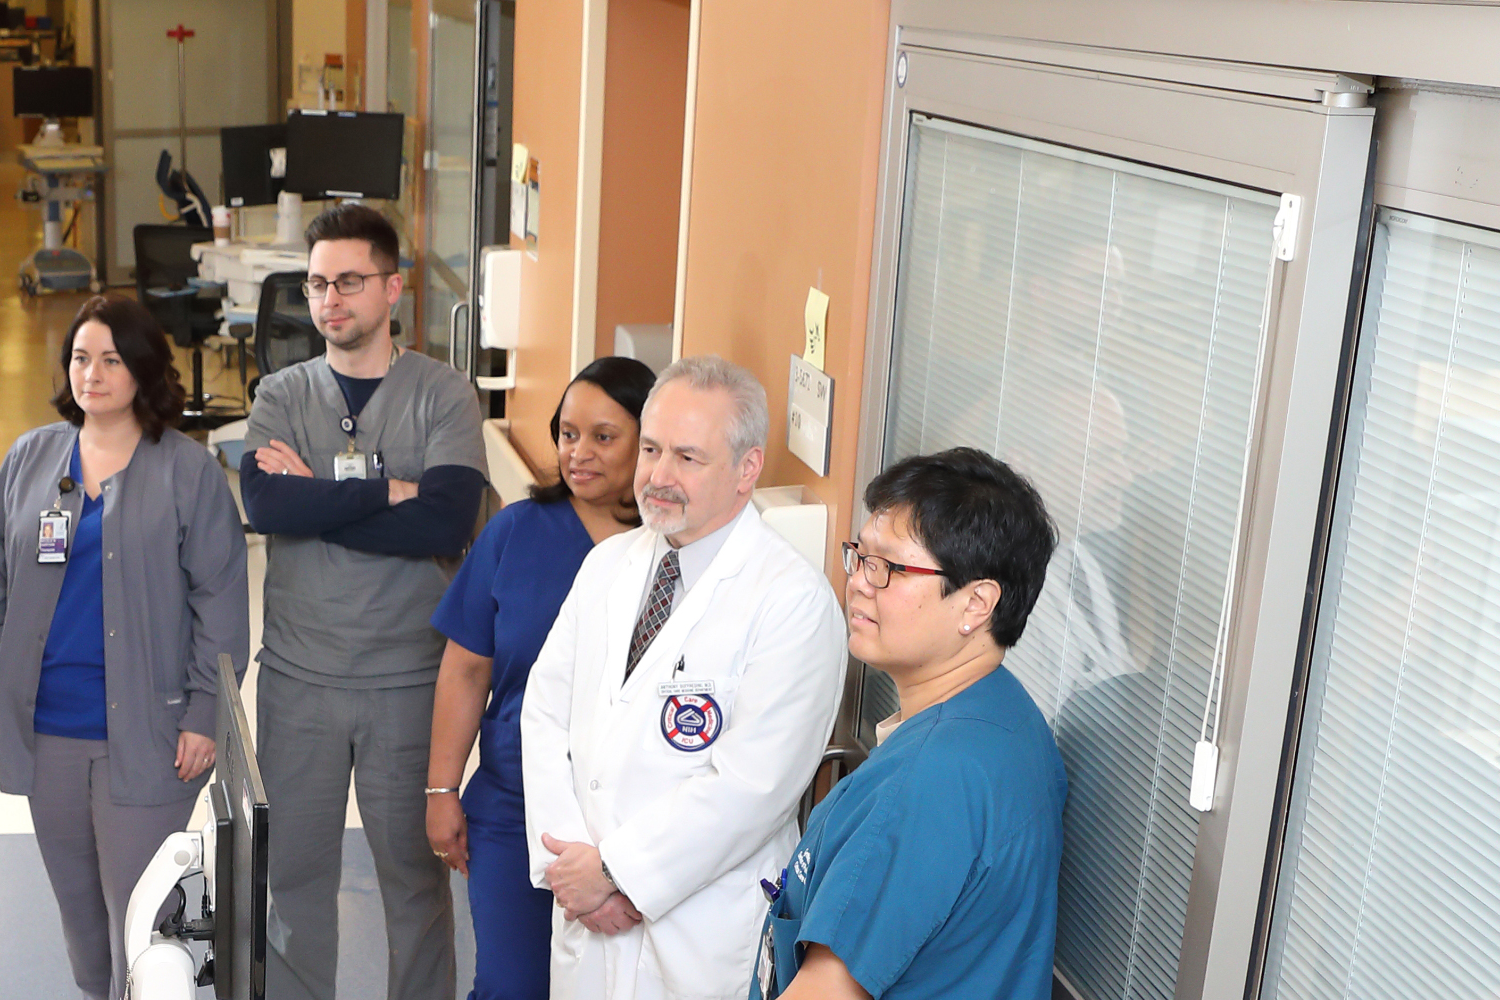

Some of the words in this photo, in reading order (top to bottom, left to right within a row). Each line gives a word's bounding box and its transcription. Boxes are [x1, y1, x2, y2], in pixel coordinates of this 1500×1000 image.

[667, 706, 675, 729] Critical
[684, 696, 698, 704] Care
[682, 725, 697, 734] NIH
[681, 737, 694, 745] ICU
